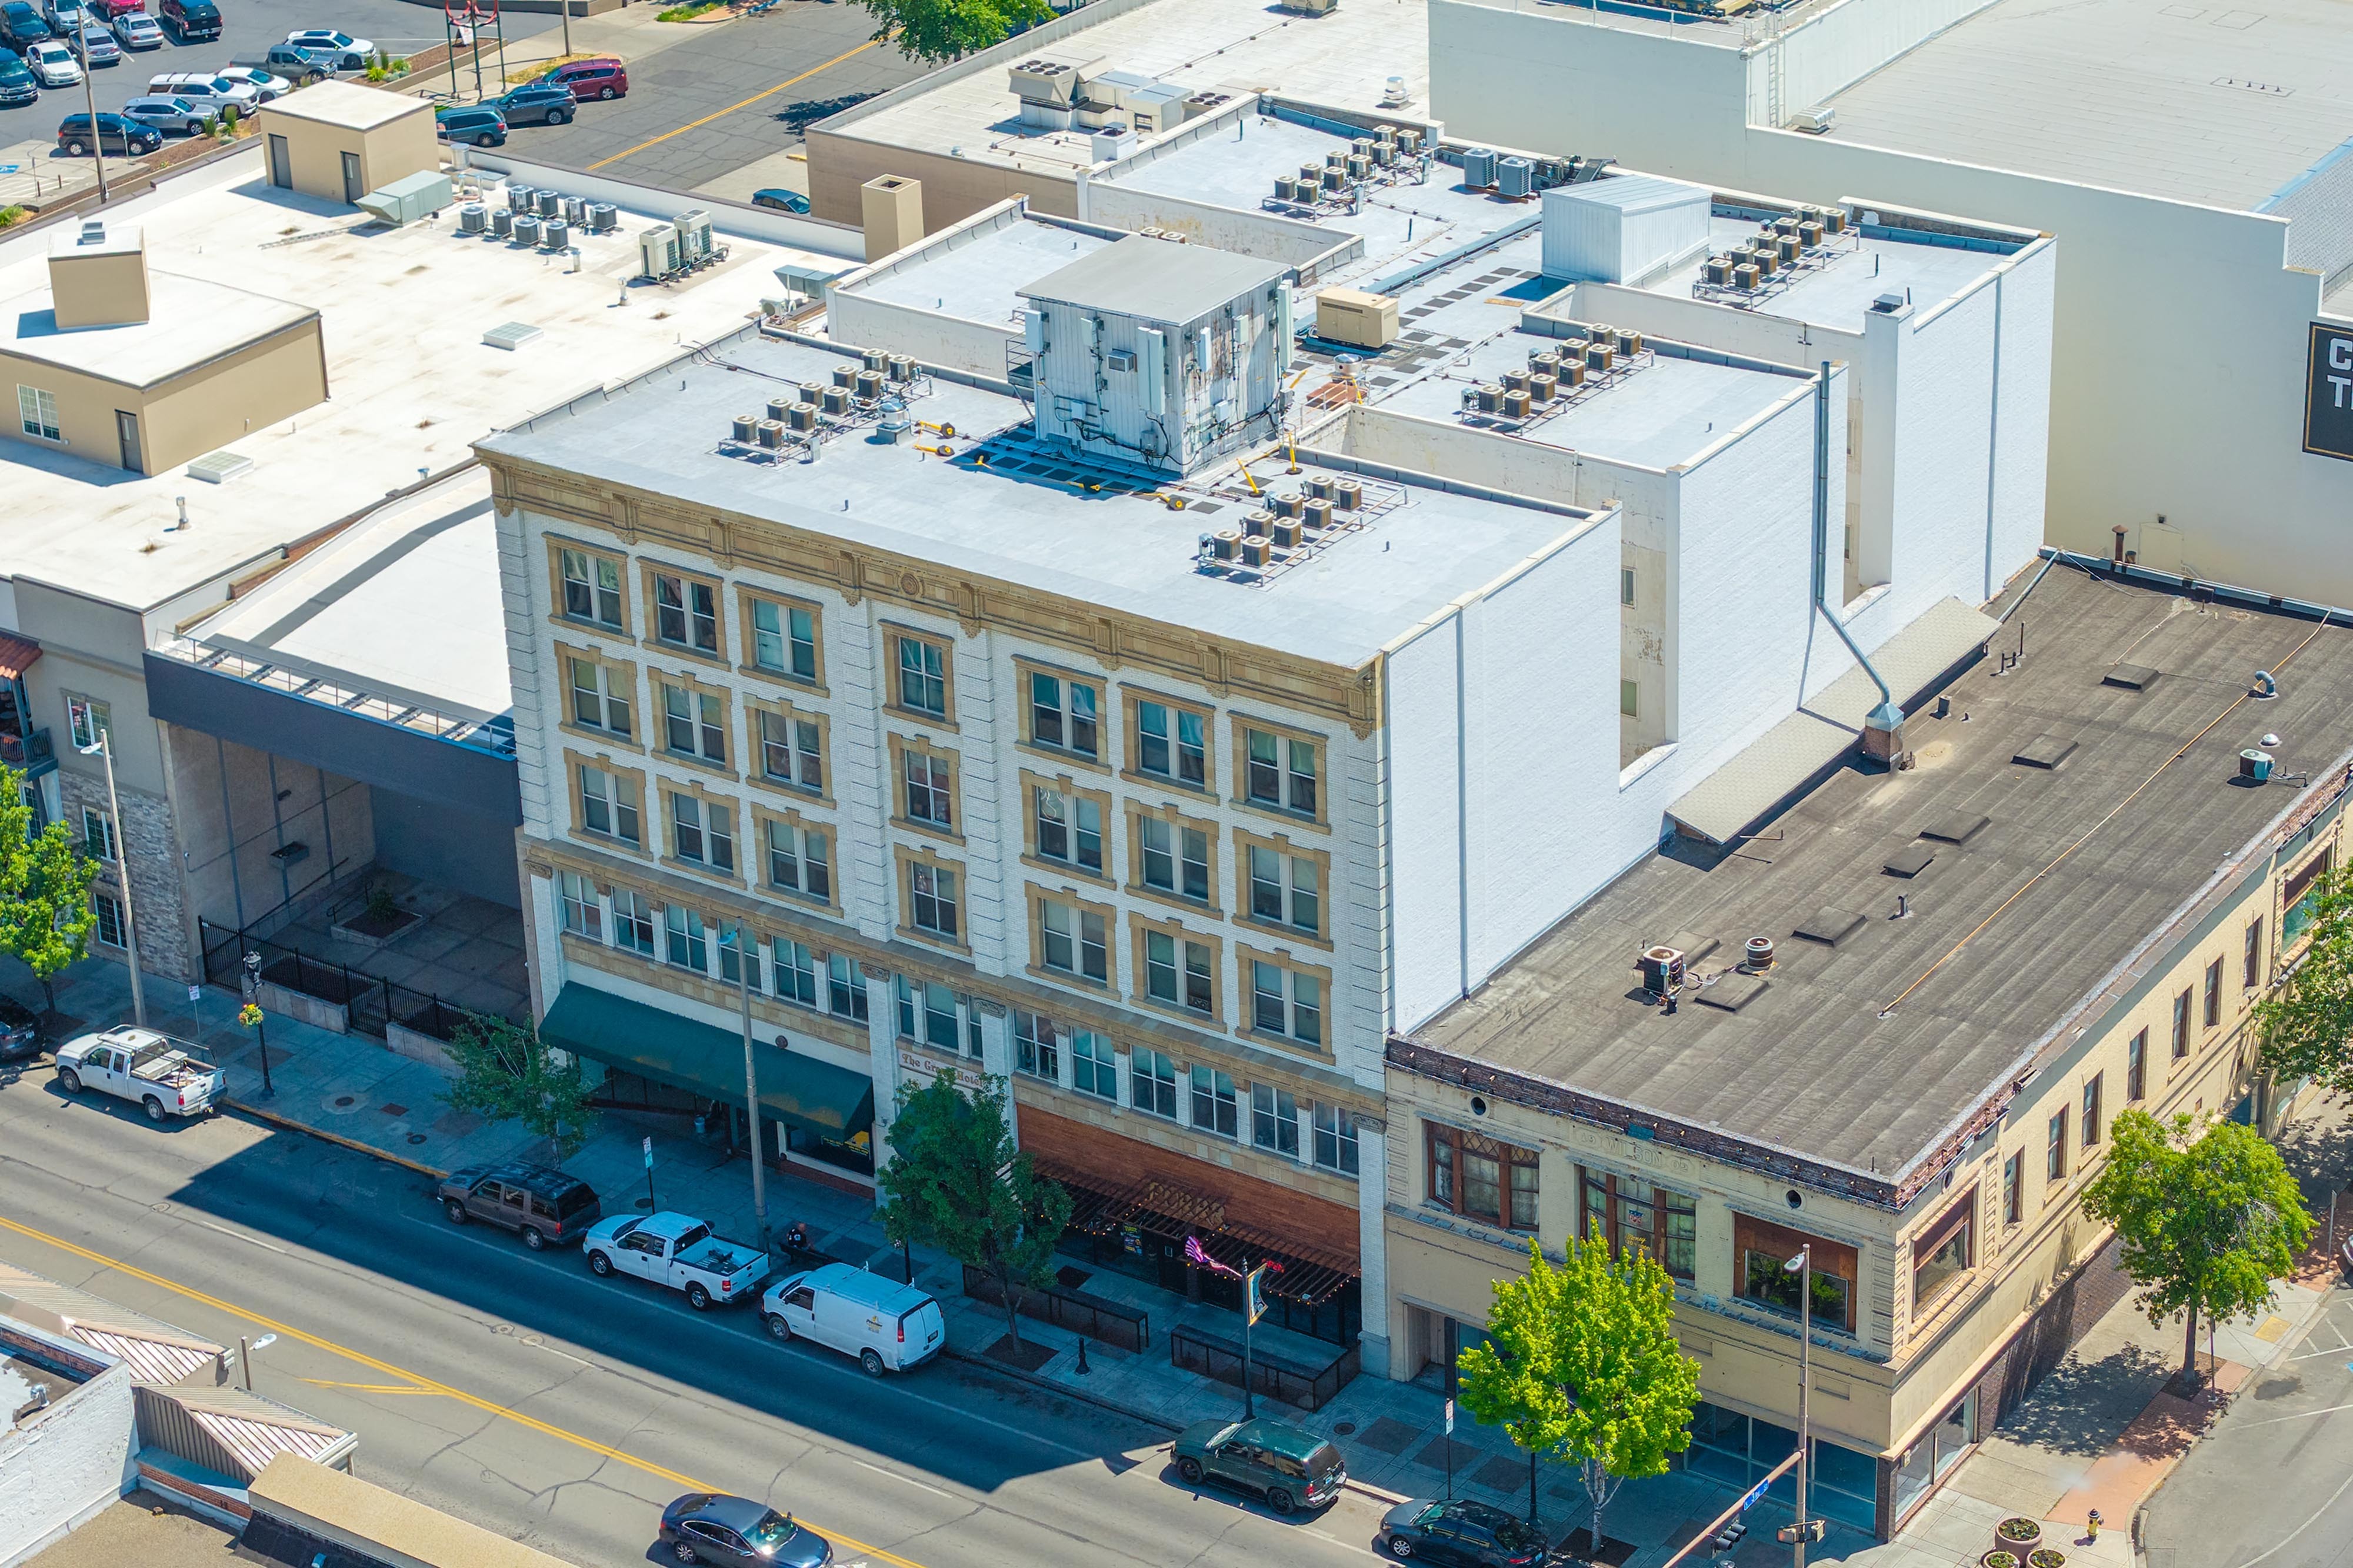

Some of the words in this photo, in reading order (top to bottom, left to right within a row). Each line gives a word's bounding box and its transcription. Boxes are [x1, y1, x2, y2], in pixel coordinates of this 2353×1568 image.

[2328, 337, 2353, 371] C
[2327, 374, 2353, 410] T
[902, 1053, 921, 1067] The
[1605, 1136, 1662, 1167] WILSON
